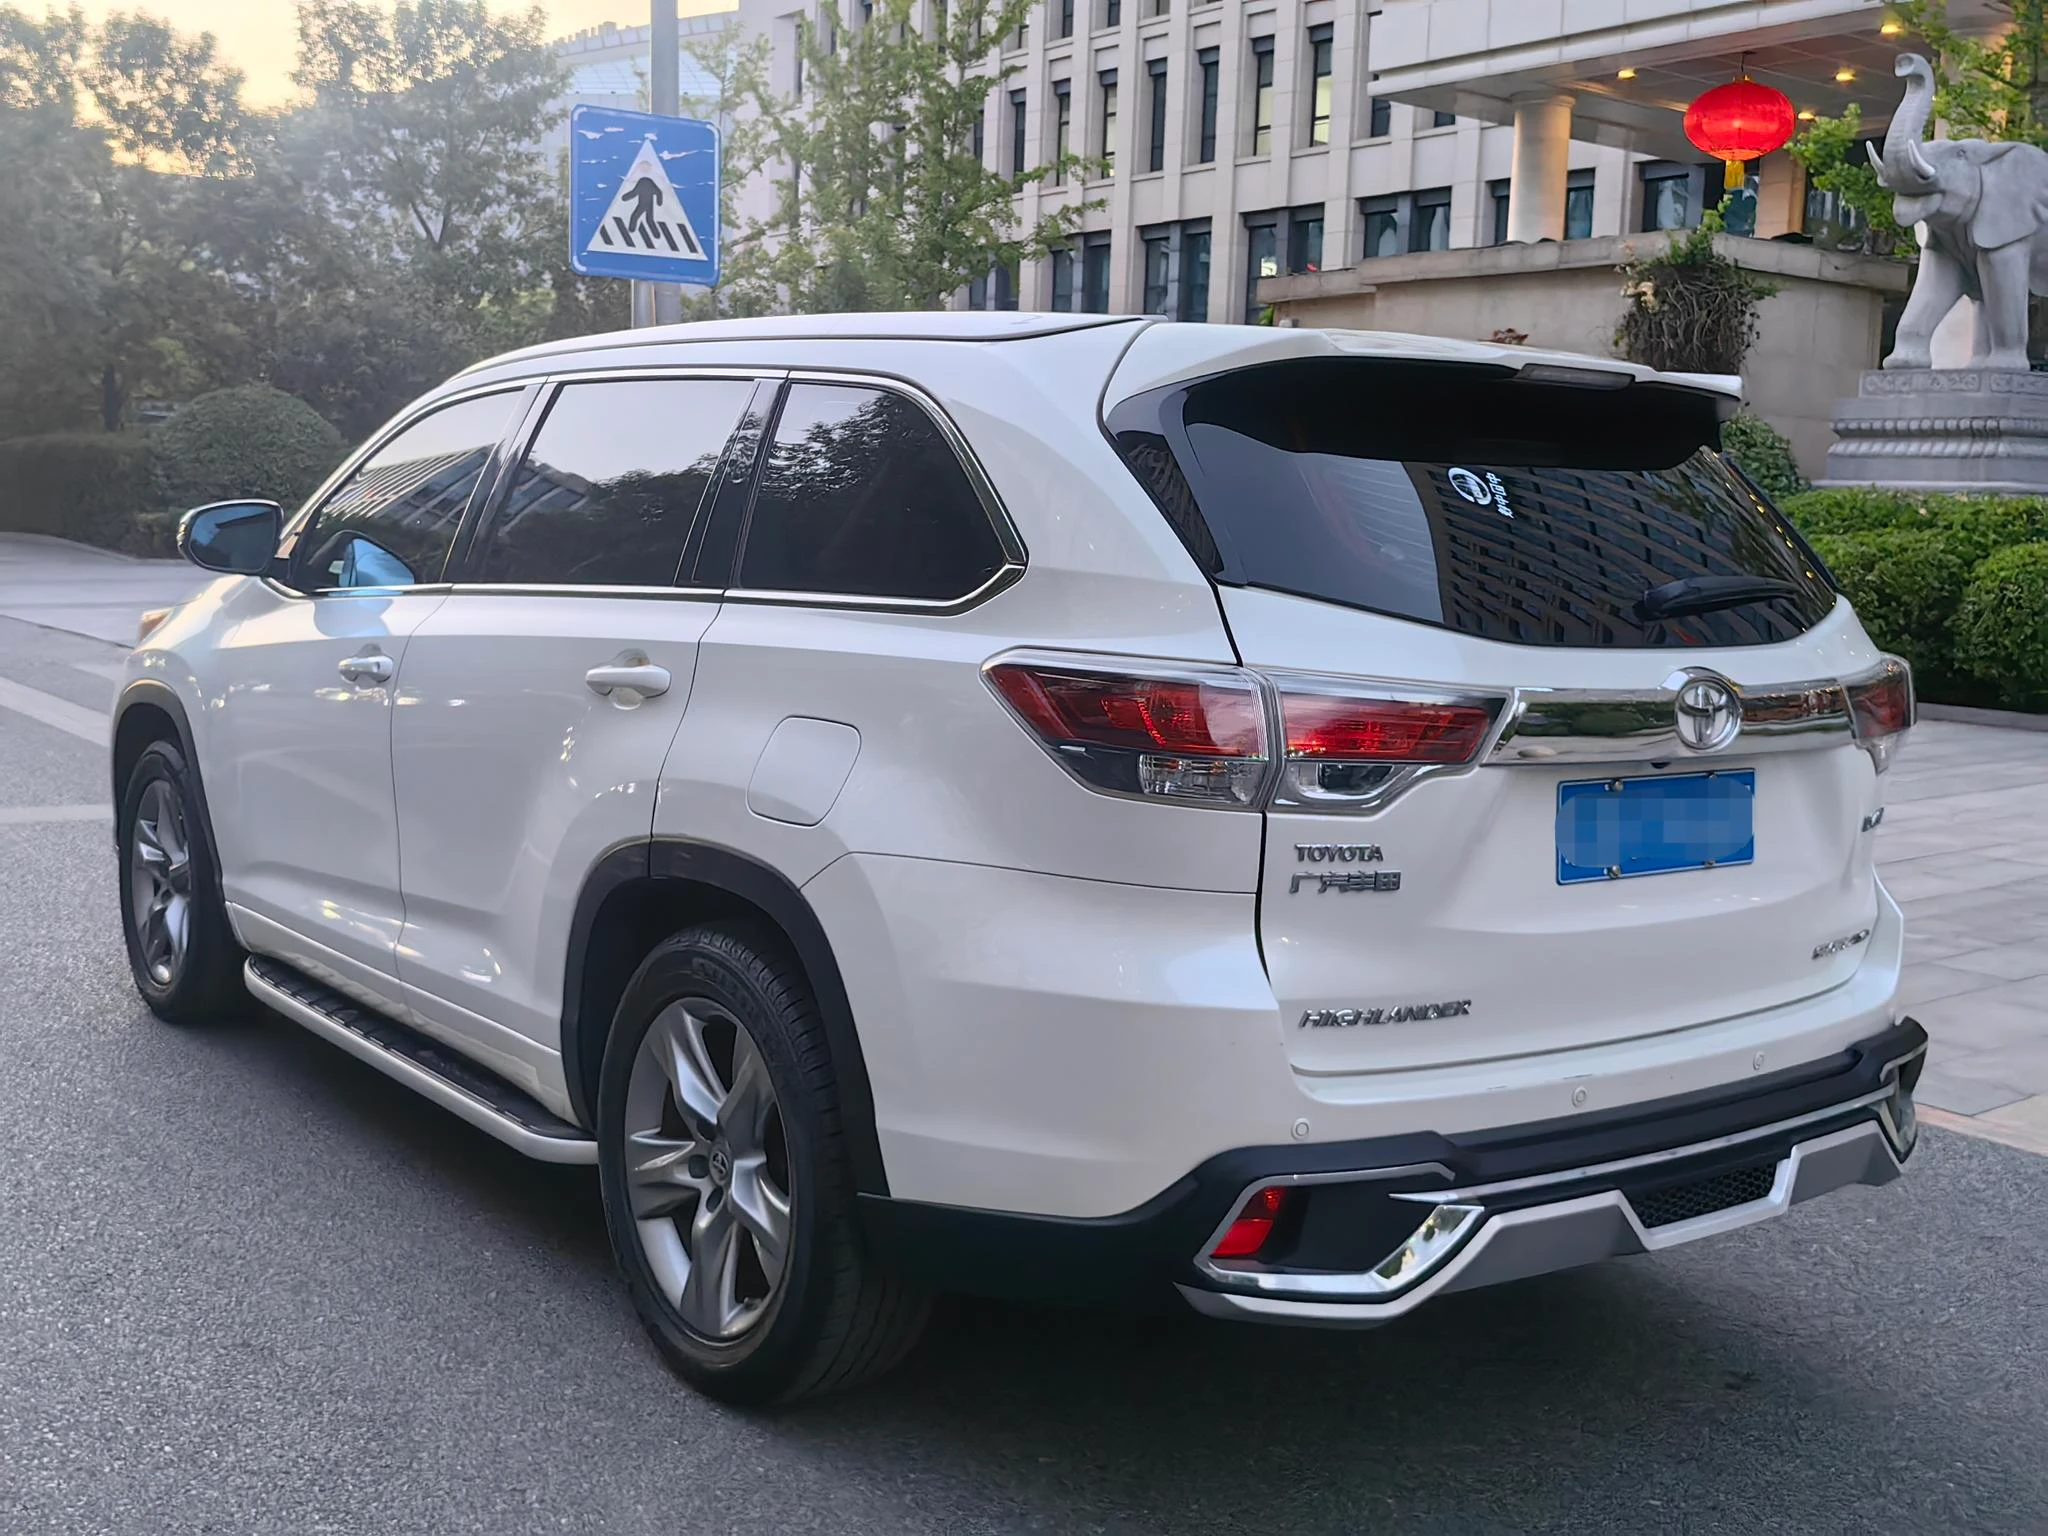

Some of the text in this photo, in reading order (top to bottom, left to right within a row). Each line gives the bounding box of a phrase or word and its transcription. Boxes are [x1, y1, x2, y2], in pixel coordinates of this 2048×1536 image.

[1294, 843, 1384, 863] TOYOTA
[1289, 870, 1402, 894] 广汽丰田
[1298, 999, 1472, 1029] HIGHLANDER
